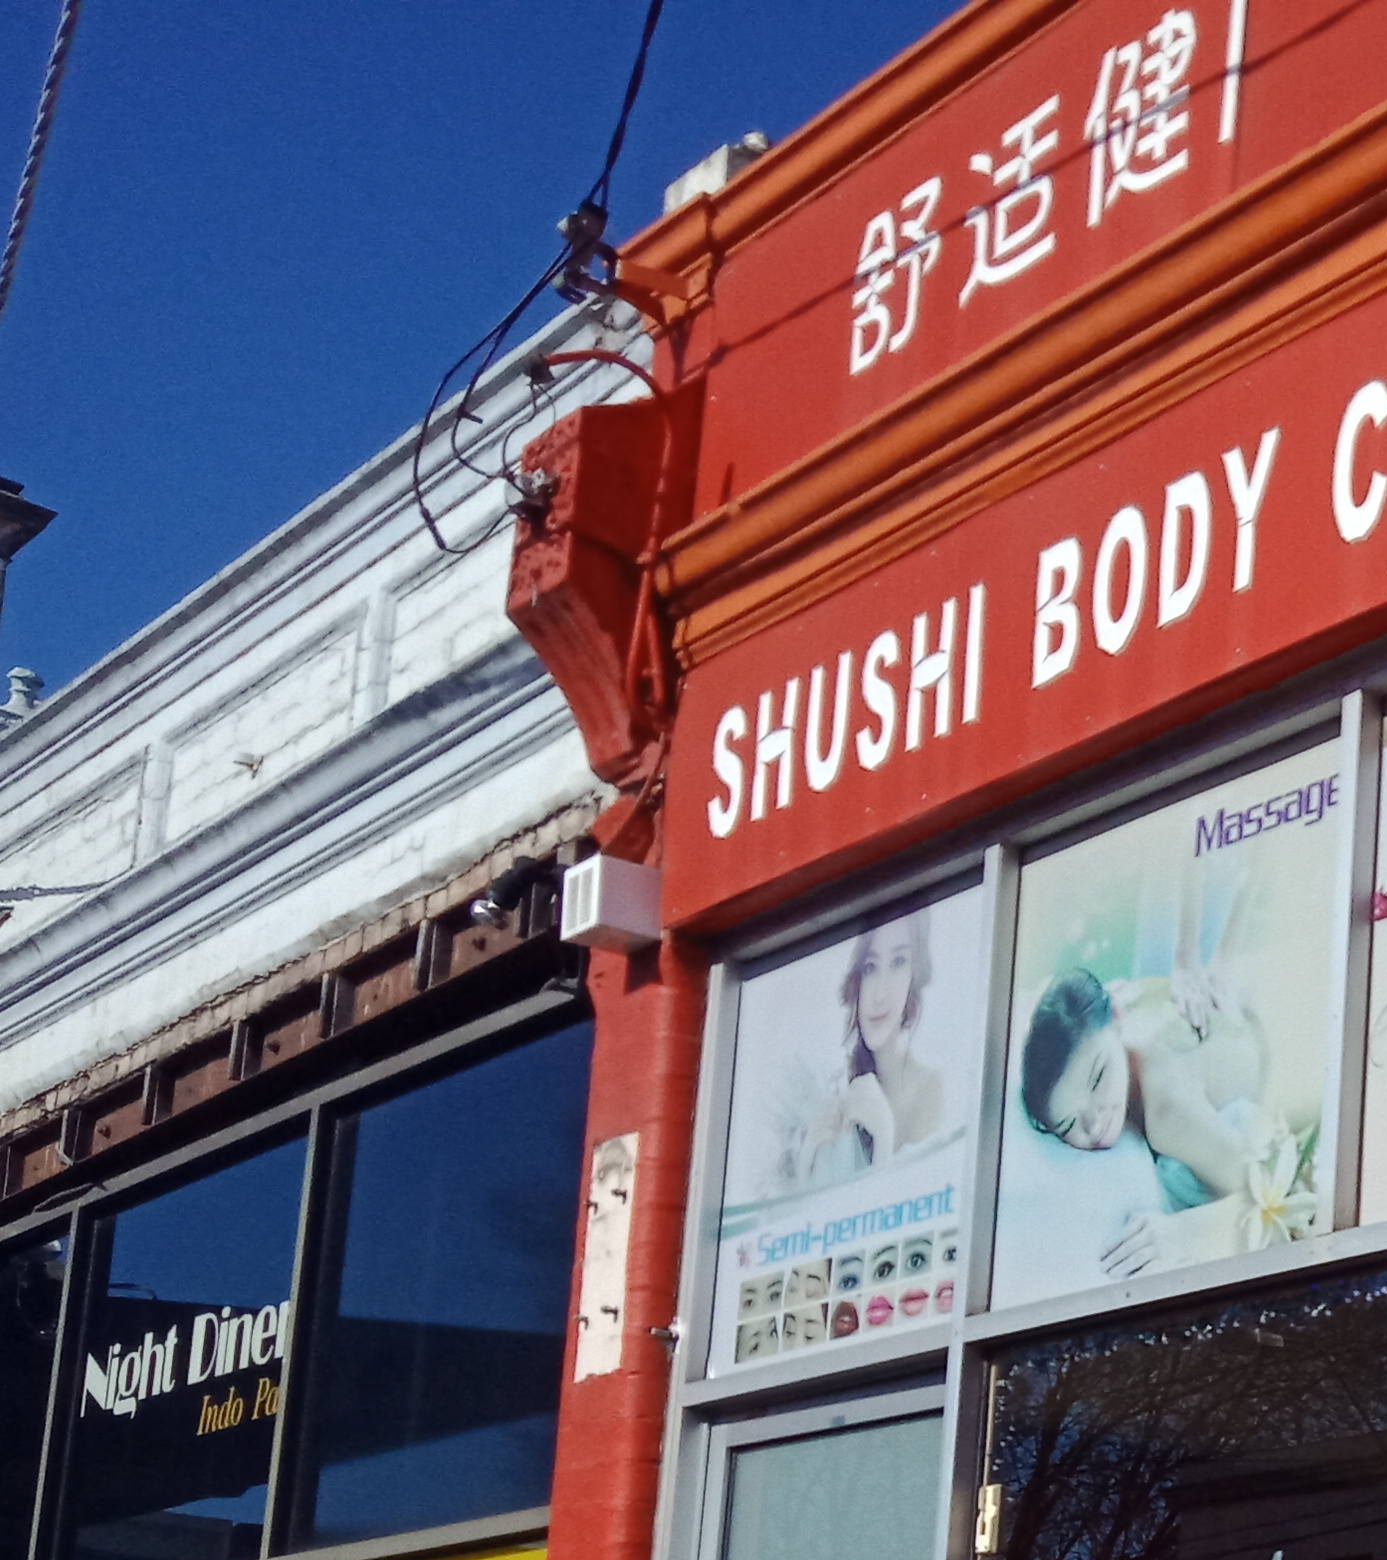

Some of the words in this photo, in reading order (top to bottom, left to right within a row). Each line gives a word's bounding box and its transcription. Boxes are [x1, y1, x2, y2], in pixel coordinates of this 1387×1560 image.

[849, 0, 1247, 376] 舒适健
[707, 581, 986, 839] SHUSHI
[1030, 426, 1281, 690] BODY
[757, 1184, 955, 1267] Semi-permanent
[79, 1323, 179, 1420] Night
[196, 1385, 244, 1436] Indo
[251, 1377, 280, 1421] Pa
